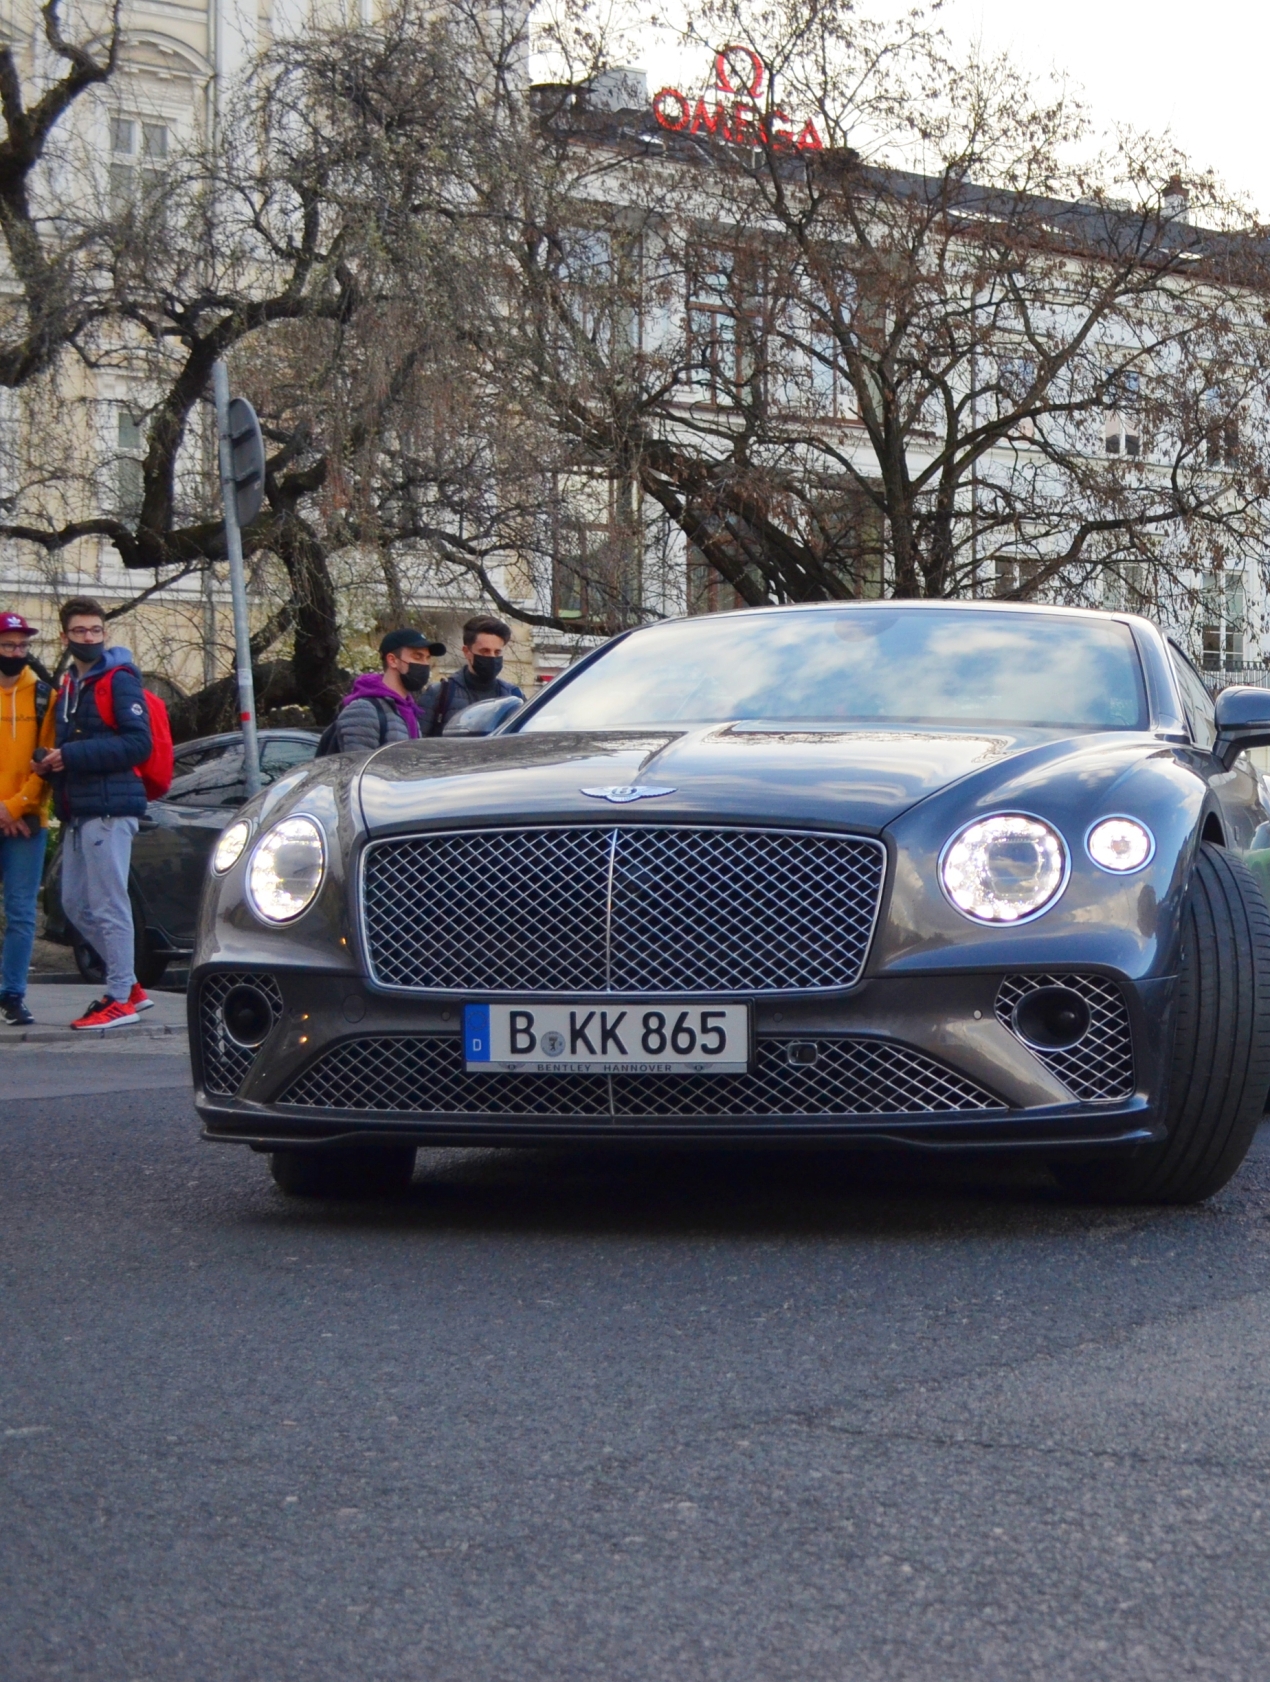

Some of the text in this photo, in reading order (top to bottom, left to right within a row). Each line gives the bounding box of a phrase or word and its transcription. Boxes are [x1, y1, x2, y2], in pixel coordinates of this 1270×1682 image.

[653, 87, 823, 153] OMEGA
[472, 1039, 482, 1051] D
[509, 1010, 728, 1055] B KK 865
[537, 1063, 673, 1073] BENTLEY HANNOVER
